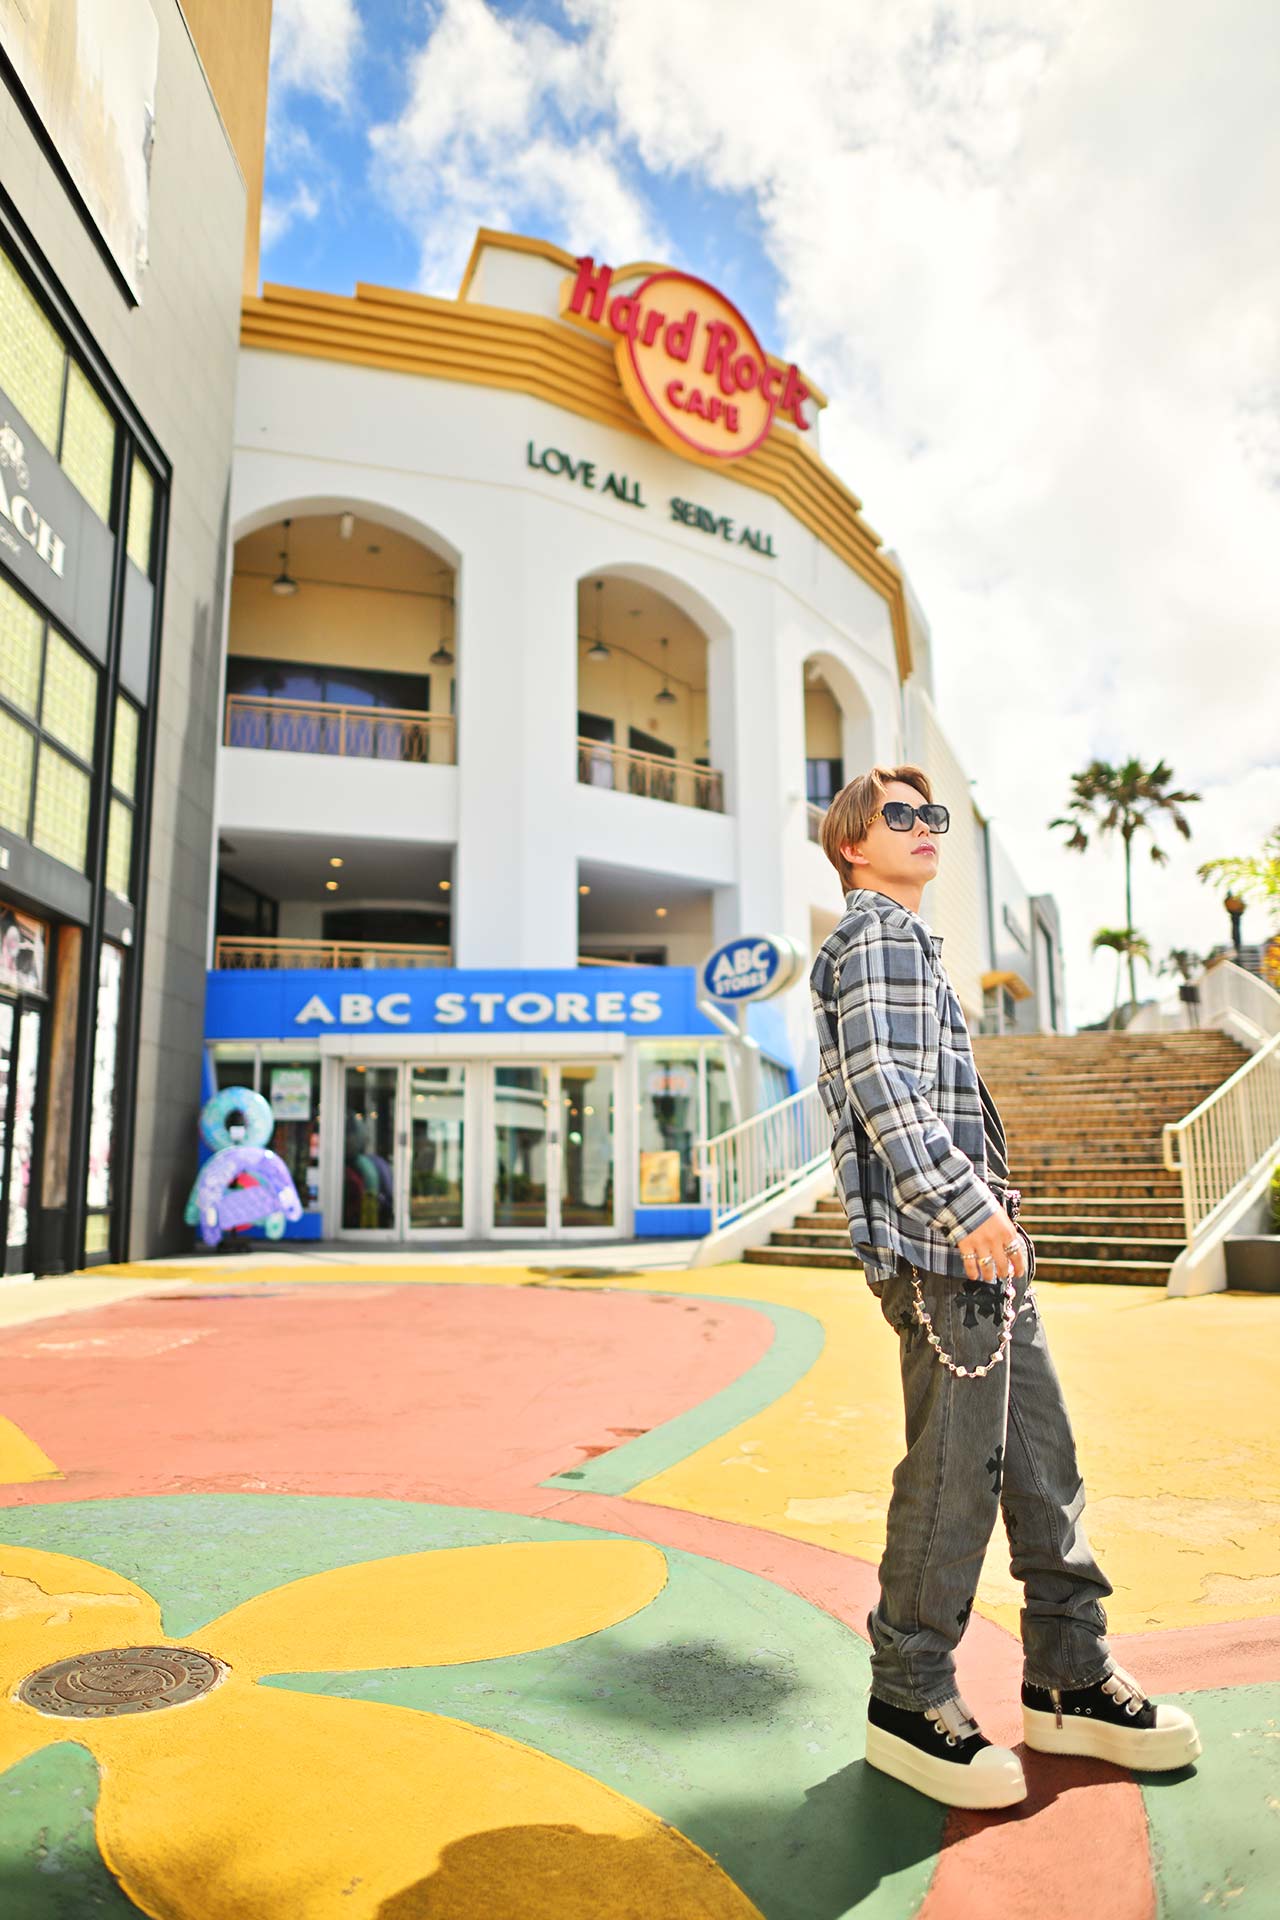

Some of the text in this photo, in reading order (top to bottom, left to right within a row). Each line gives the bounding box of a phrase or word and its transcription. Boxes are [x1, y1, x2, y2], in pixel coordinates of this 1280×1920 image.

[568, 256, 810, 430] Hard Rock
[666, 380, 740, 433] CAFE
[527, 441, 777, 557] LOVE ALL SERVE ALL
[712, 942, 770, 981] ABC
[714, 970, 767, 996] STORES
[296, 991, 662, 1024] ABC STORES
